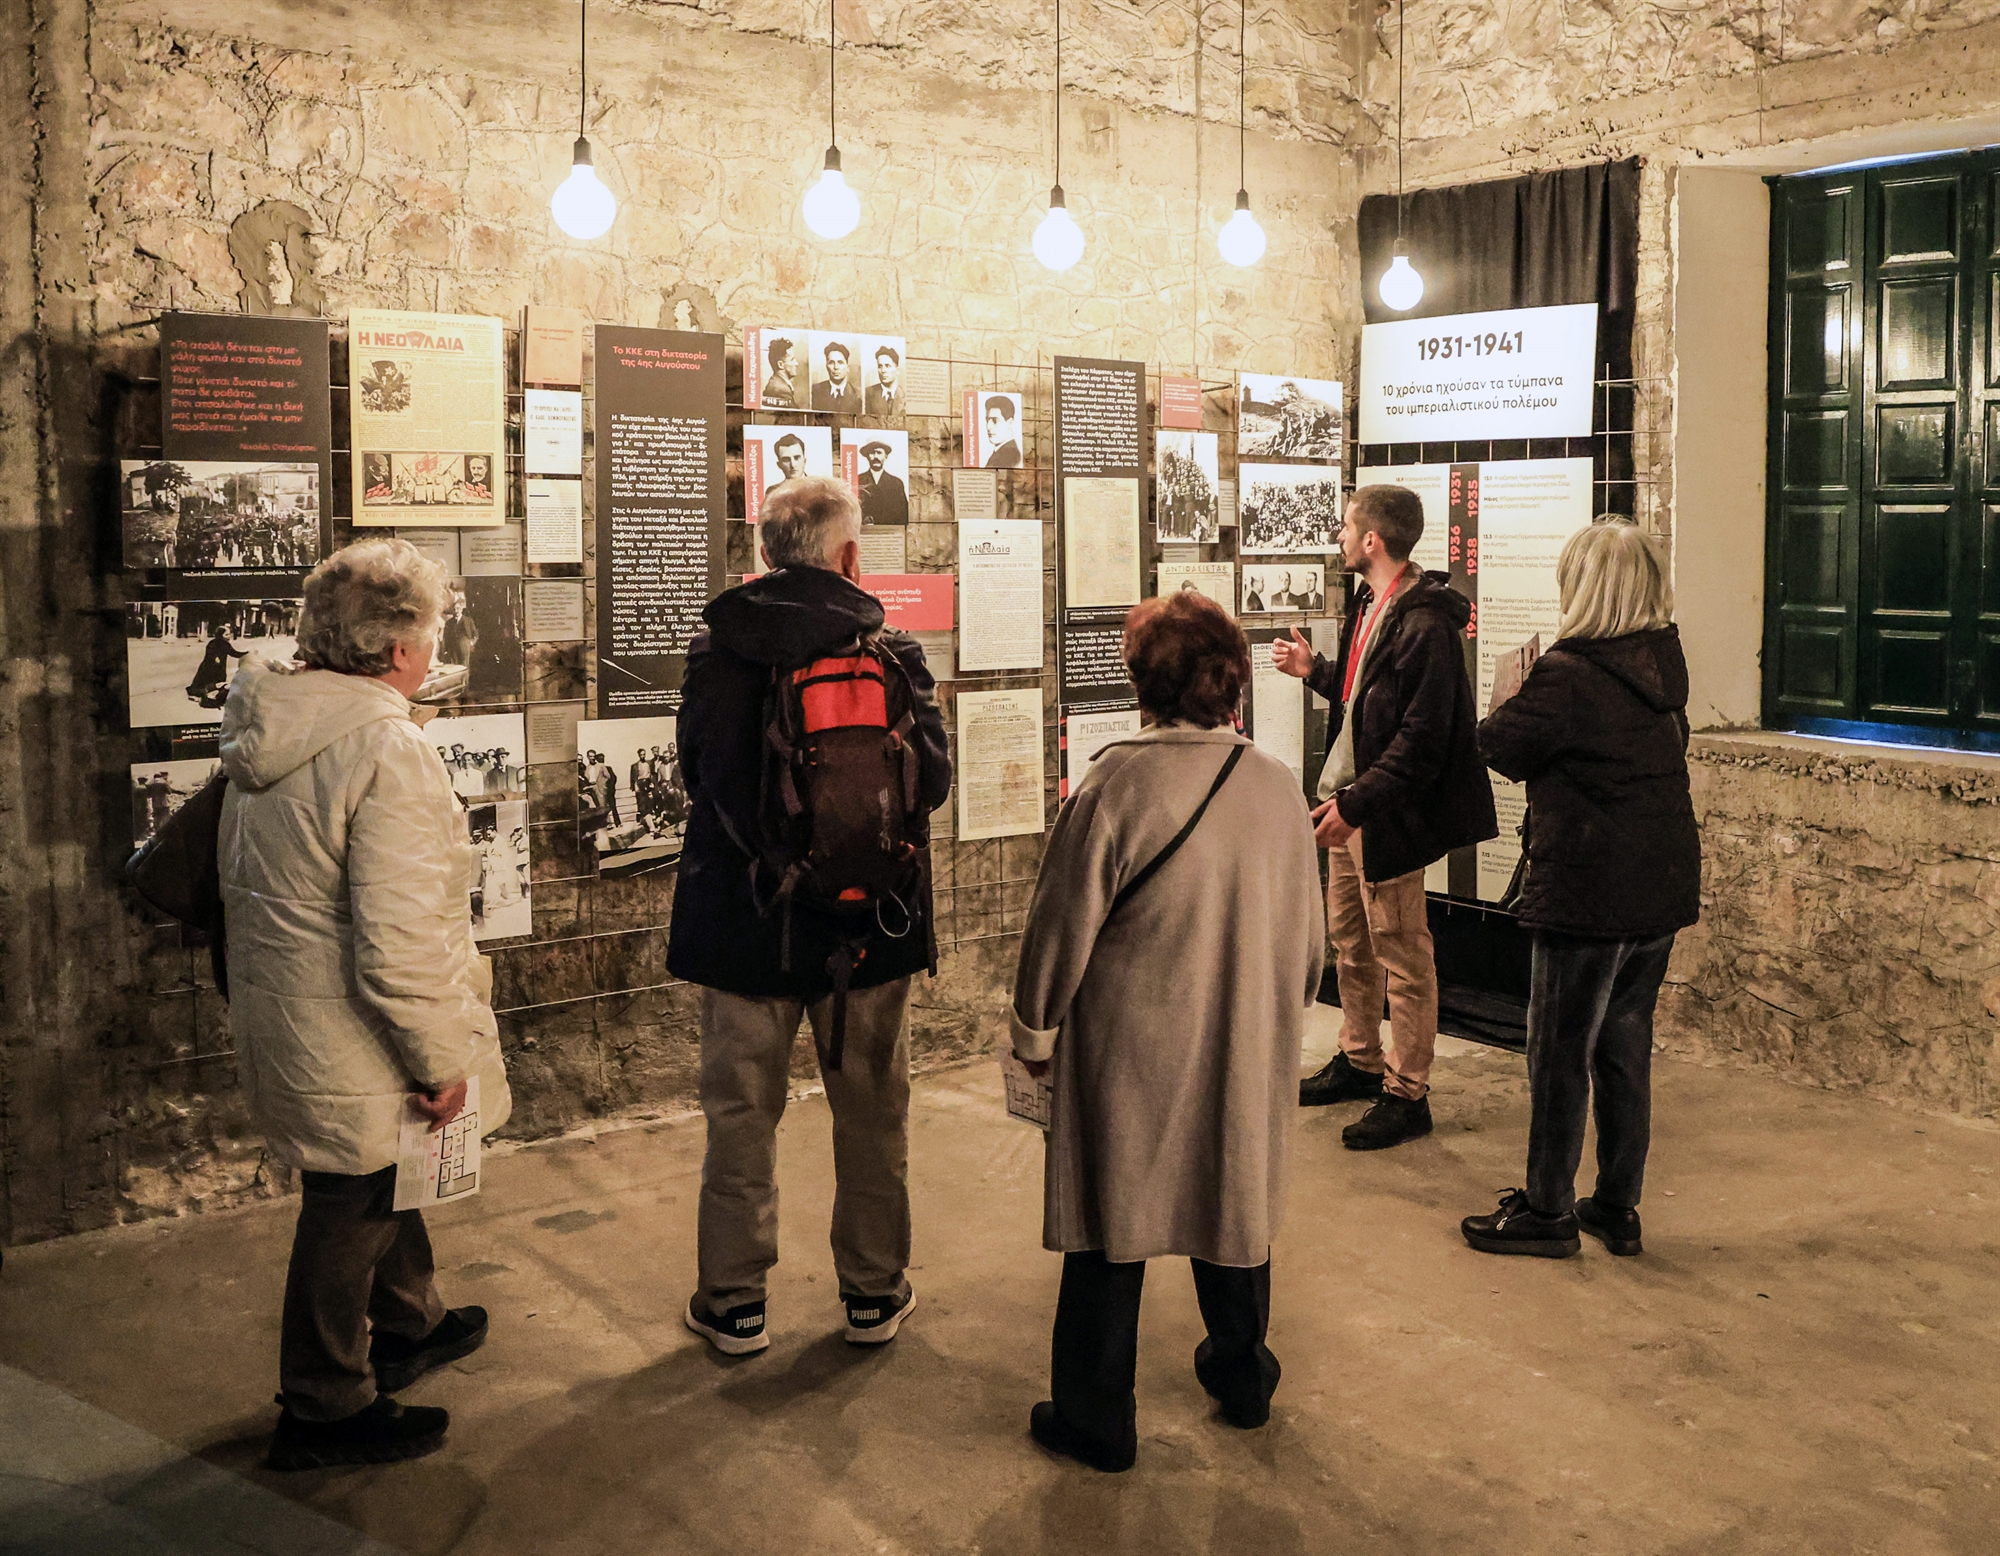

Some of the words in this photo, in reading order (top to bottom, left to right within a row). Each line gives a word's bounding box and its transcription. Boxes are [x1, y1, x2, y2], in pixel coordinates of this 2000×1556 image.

[358, 331, 369, 345] Η
[1418, 331, 1523, 360] 1931-1941
[613, 346, 624, 354] Το
[625, 347, 643, 356] ΚΚΕ
[644, 350, 660, 358] στη
[661, 349, 708, 361] δικτατορία
[620, 359, 636, 367] της
[637, 359, 653, 368] 4ης
[655, 359, 700, 371] Αυγούστου
[748, 332, 757, 378] Ζαχαριάδης
[749, 380, 757, 402] Νίκος
[1383, 385, 1393, 396] 10
[1396, 382, 1433, 398] χρόνια
[1436, 379, 1485, 394] ηχούσαν
[1491, 380, 1503, 389] τα
[1508, 374, 1563, 390] τύμπανα
[1386, 406, 1404, 415] του
[1407, 396, 1499, 416] ιμπεριαλιστικού
[1503, 393, 1557, 411] πολέμου
[749, 444, 757, 481] Μαλτέζος
[1451, 472, 1461, 505] 1931
[1468, 480, 1478, 517] 1935
[632, 507, 667, 515] Αυγούστου
[692, 508, 708, 516] εισή-
[1450, 525, 1460, 562] 1936
[1466, 538, 1477, 575] 1938
[1080, 720, 1130, 734] ΡΙΖΟΣΠΑΣΤΗΣ
[736, 1314, 763, 1329] PUMA
[851, 1308, 880, 1320] PUMA
